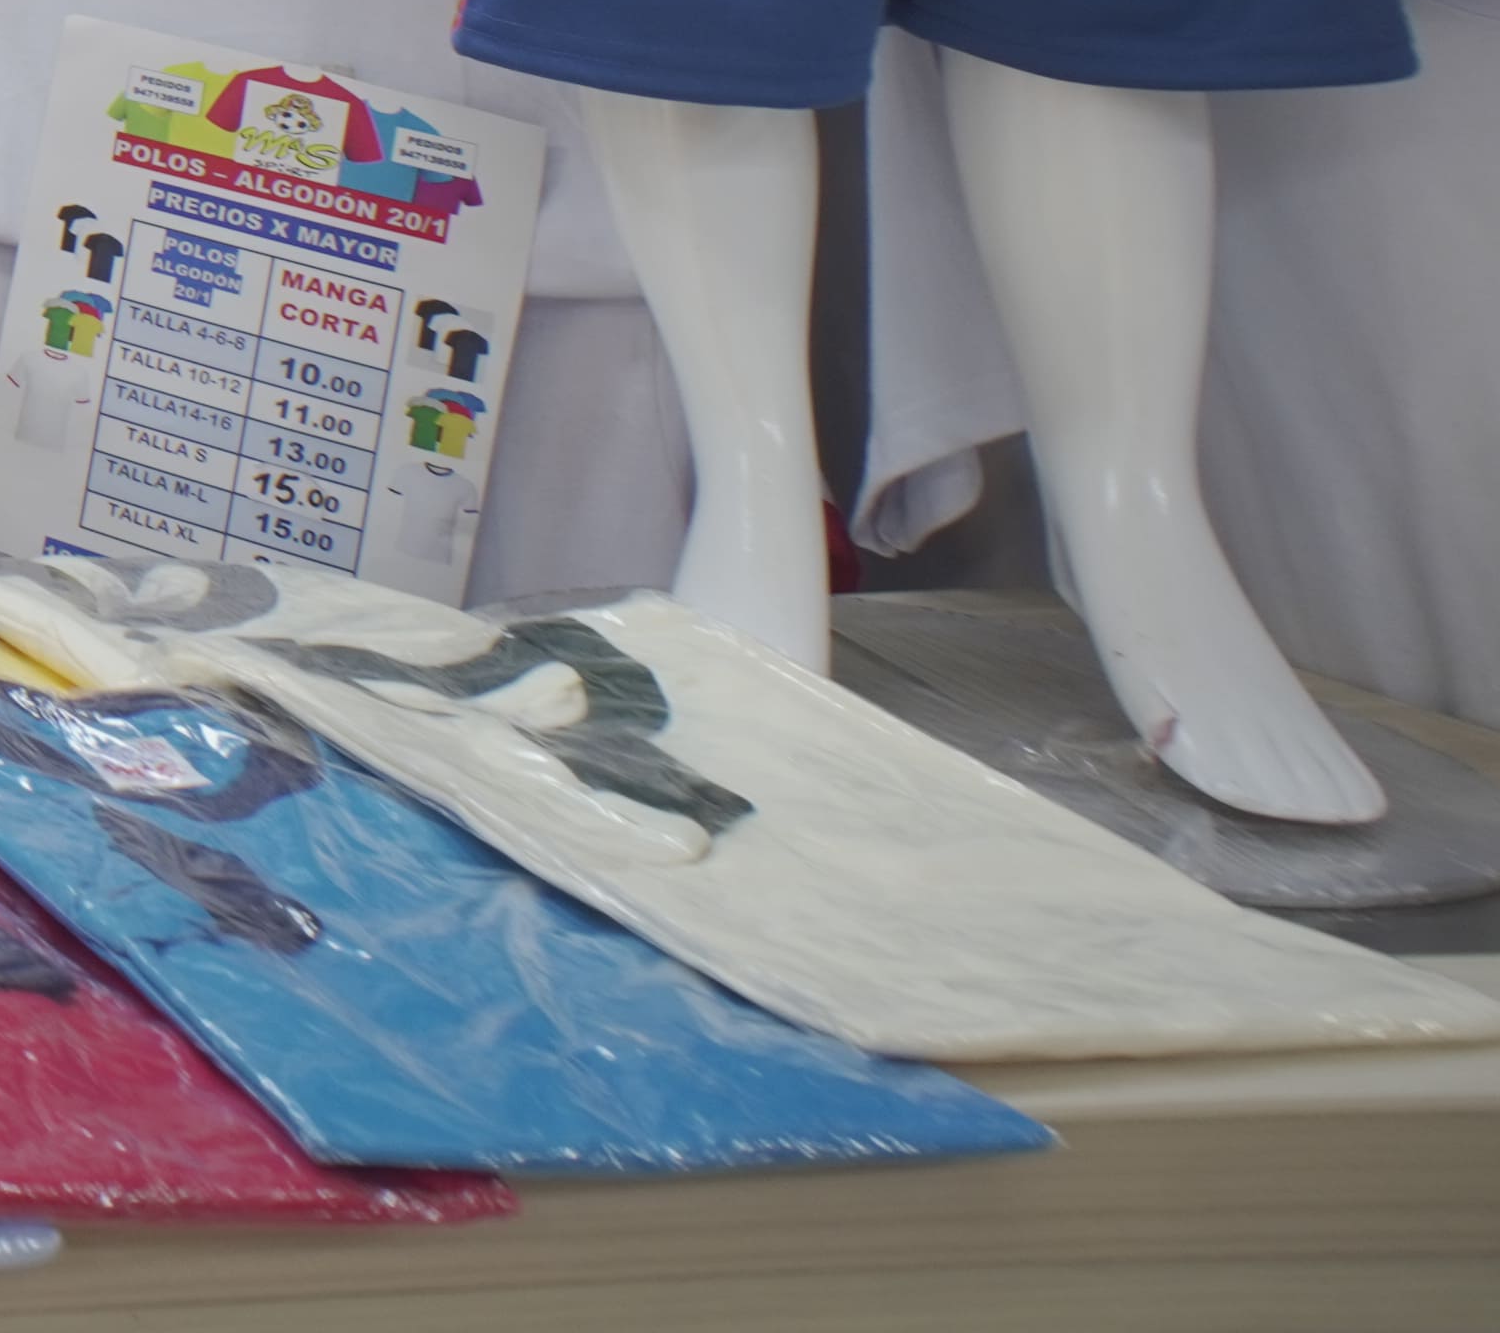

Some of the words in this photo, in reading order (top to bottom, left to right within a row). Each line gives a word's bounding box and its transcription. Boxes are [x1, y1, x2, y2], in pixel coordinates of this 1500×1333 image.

[140, 73, 192, 94] PEDIDOS
[405, 135, 464, 157] PEDIDOS
[114, 137, 206, 178] POLOS
[234, 169, 378, 223] ALGODÓN
[386, 207, 448, 238] 20/1
[148, 187, 262, 233] PRECIOS
[270, 219, 289, 238] X
[297, 223, 398, 267] MAYOR
[163, 235, 238, 268] POLOS
[151, 256, 243, 292] ALGODÓN
[173, 284, 212, 306] 20/1
[280, 268, 389, 314] MANGA
[279, 302, 380, 345] CORTA
[128, 305, 191, 337] TALLA
[195, 325, 247, 351] 4-6-8
[279, 356, 363, 399] 10.00
[119, 345, 182, 378] TALLA
[188, 366, 242, 395] 10-12
[274, 399, 354, 437] 11.00
[126, 426, 189, 459] TALLA
[194, 447, 209, 464] S
[253, 472, 340, 515] 15.00
[268, 437, 347, 476] 13.00
[106, 459, 169, 492] TALLA
[173, 480, 210, 505] M-L
[255, 512, 334, 553] 15.00
[108, 501, 171, 535] TALLA
[175, 524, 200, 545] XL
